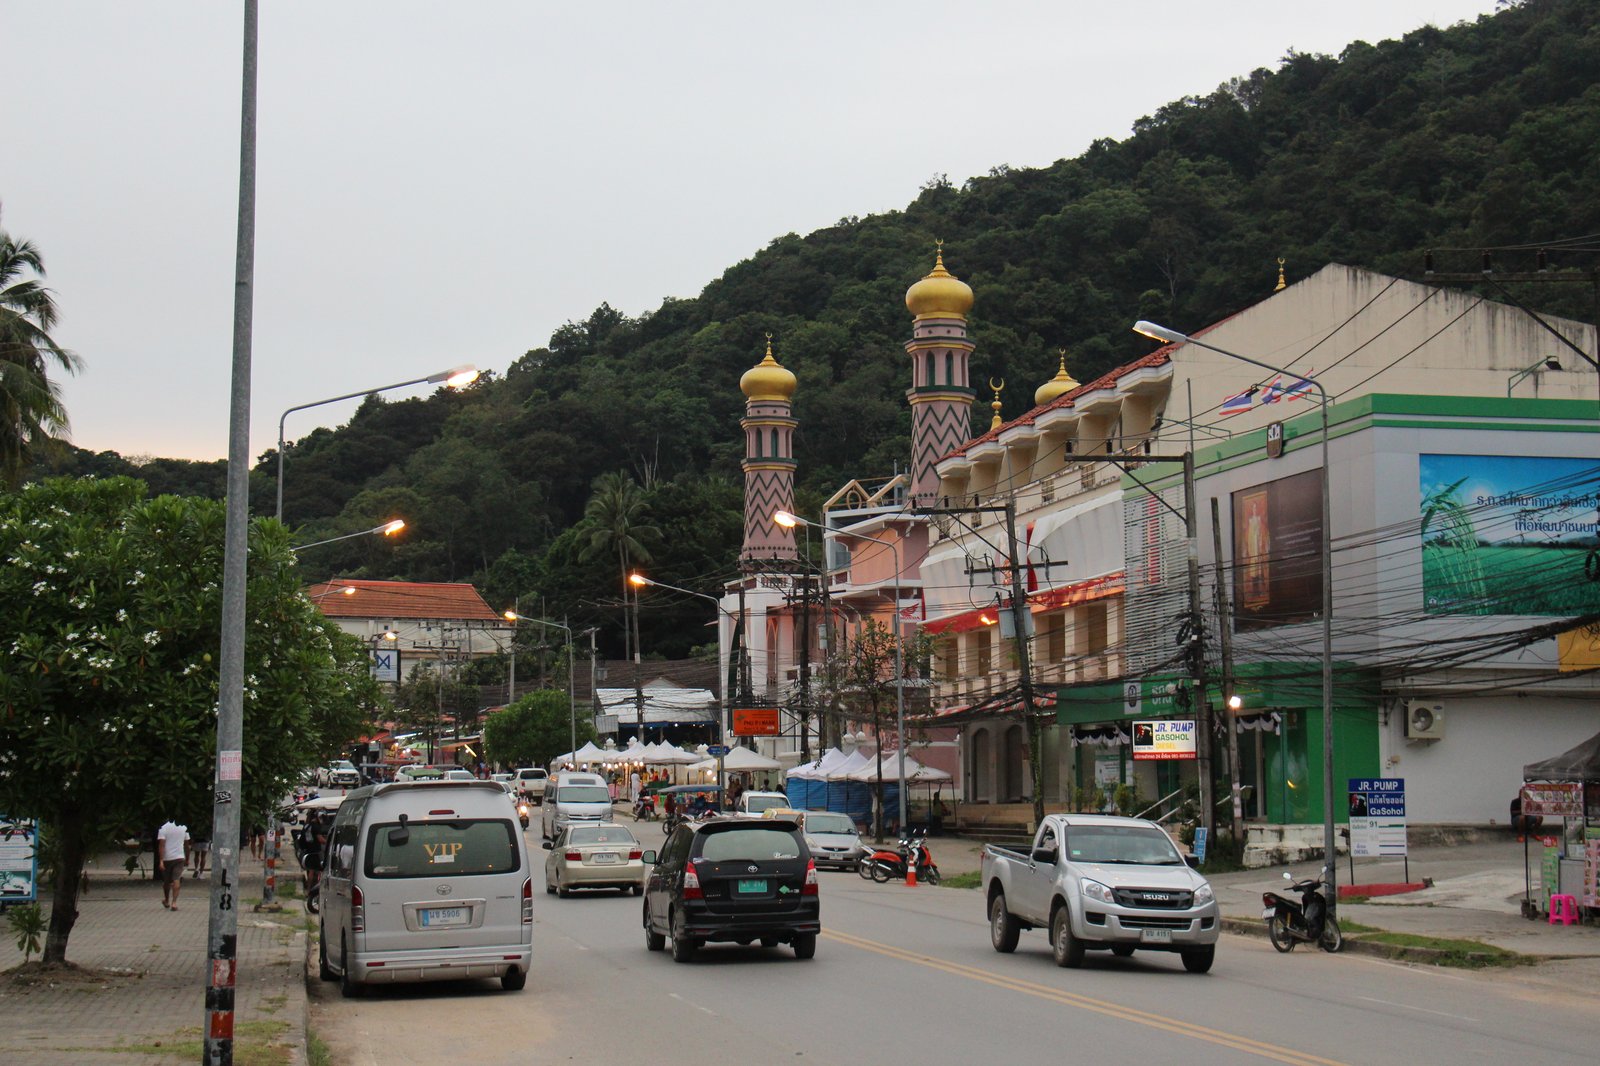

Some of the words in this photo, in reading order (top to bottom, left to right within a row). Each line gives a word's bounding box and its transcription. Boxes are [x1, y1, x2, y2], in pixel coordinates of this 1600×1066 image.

[1155, 723, 1167, 733] JR.
[1171, 722, 1194, 733] PUMP
[1358, 781, 1372, 791] JR.
[1374, 781, 1398, 791] PUMP
[1370, 807, 1404, 815] GaSohol
[1369, 820, 1378, 828] 91
[424, 843, 463, 857] VIP
